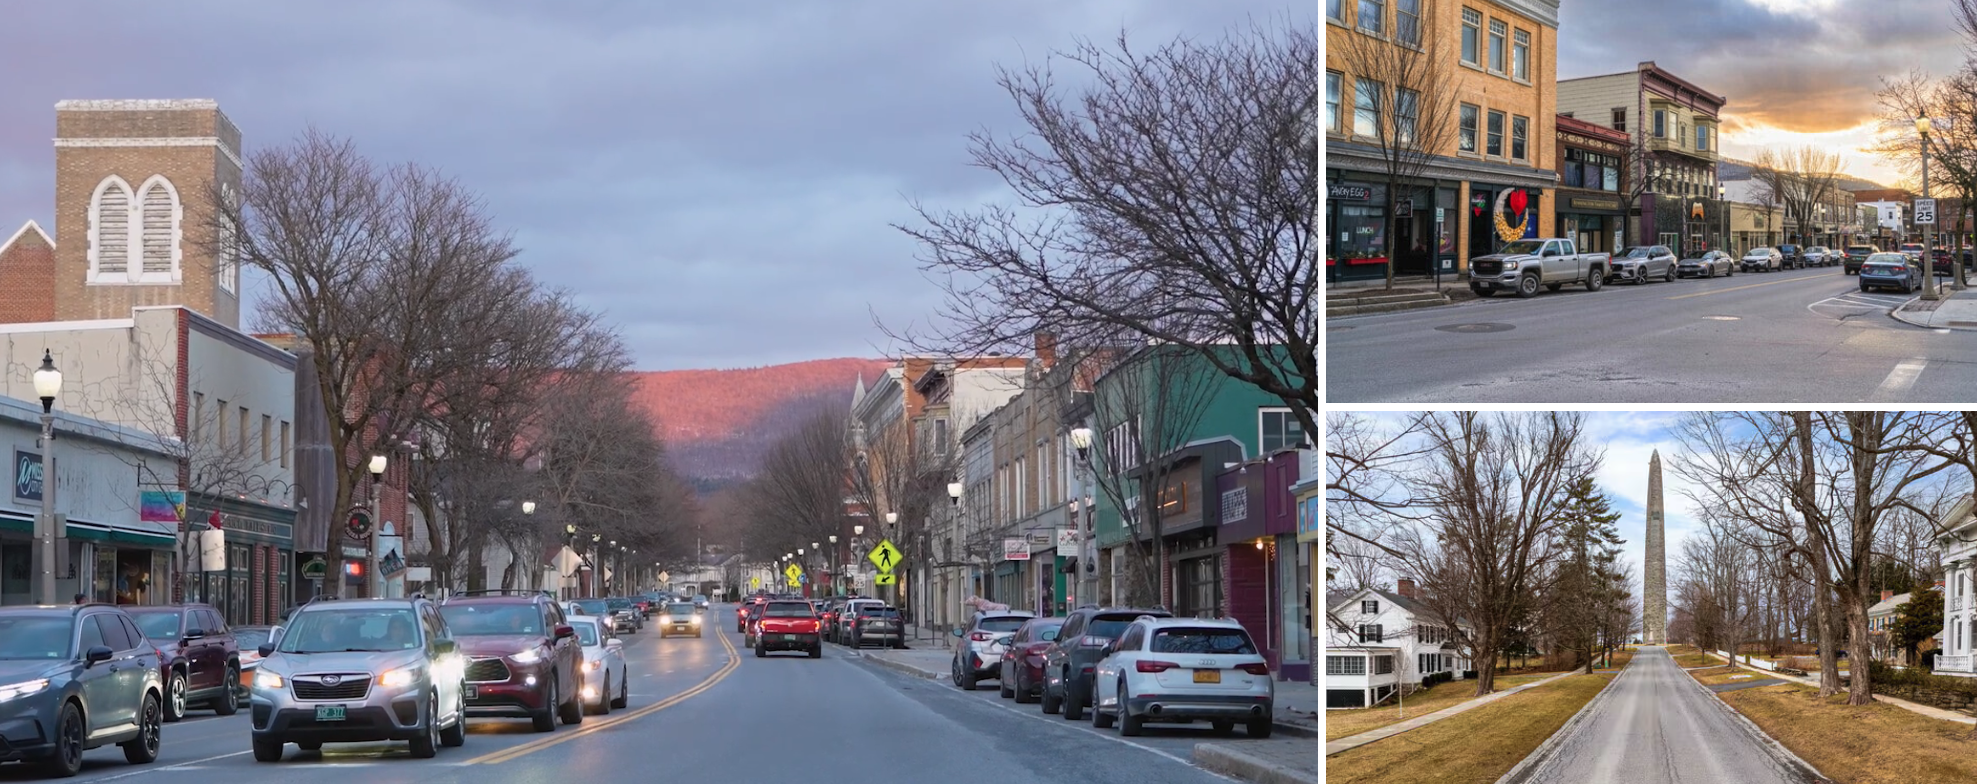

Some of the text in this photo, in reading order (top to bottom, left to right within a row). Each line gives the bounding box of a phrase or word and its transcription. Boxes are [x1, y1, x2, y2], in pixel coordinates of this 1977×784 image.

[1350, 188, 1364, 197] EGG
[1363, 190, 1370, 201] 2
[1917, 212, 1933, 221] 25
[1356, 226, 1374, 235] LUNCH
[382, 561, 403, 576] OPEN
[333, 708, 345, 717] 377
